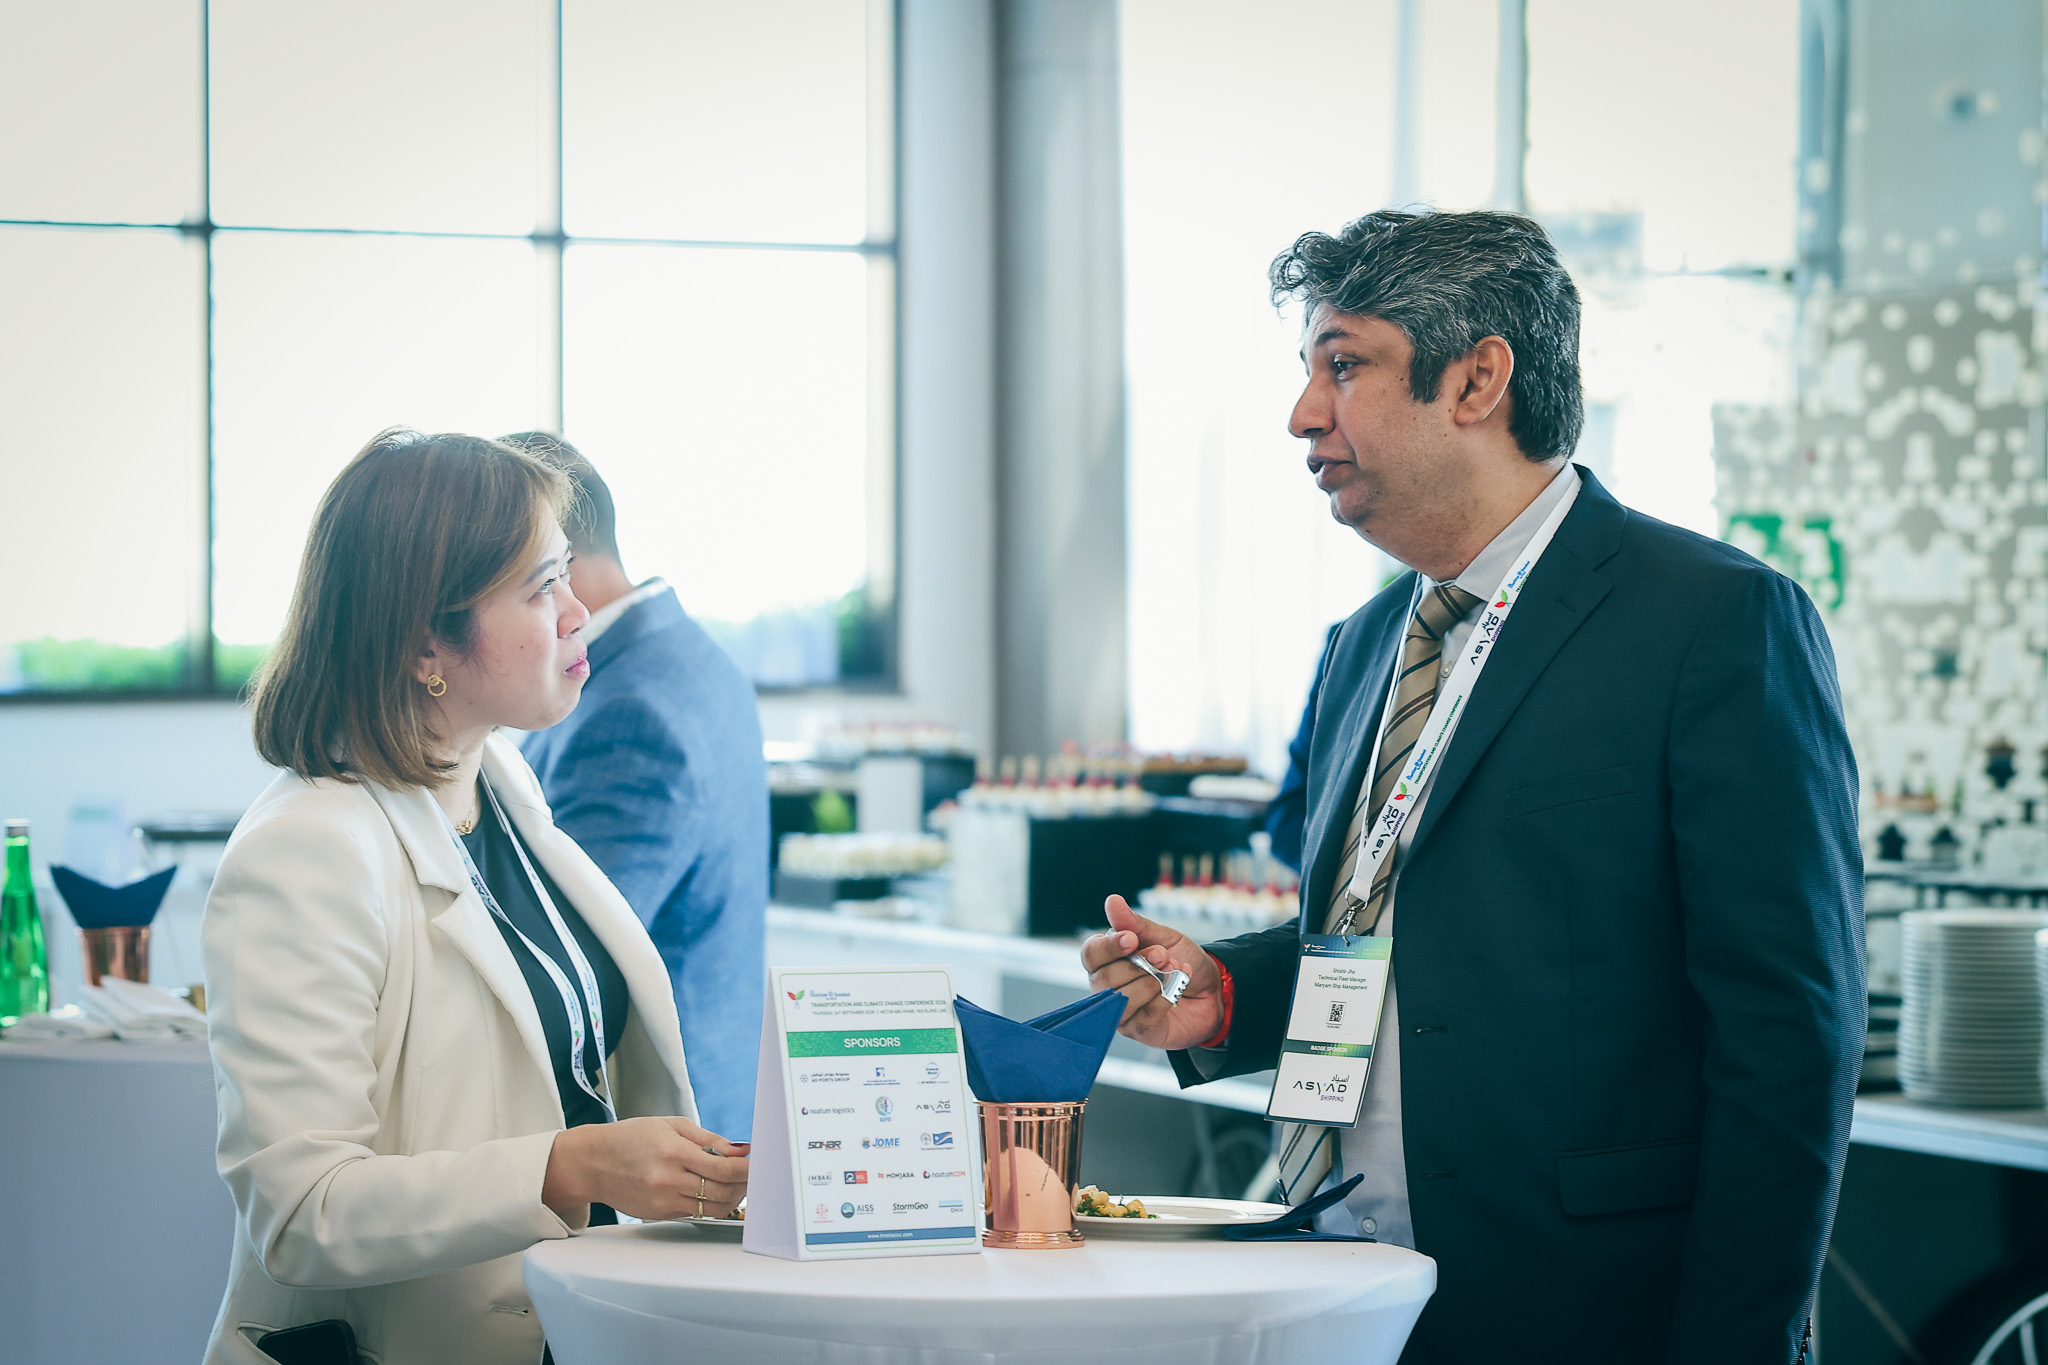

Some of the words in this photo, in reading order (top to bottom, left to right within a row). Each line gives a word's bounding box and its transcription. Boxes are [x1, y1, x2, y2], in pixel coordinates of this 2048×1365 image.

[1471, 615, 1499, 666] ASYAD
[1391, 811, 1406, 836] SHIPPING
[1371, 808, 1399, 860] ASYAD
[843, 1036, 901, 1048] SPONSORS
[1293, 1080, 1347, 1095] ASYAD
[1320, 1094, 1345, 1102] SHIPPING
[832, 1107, 855, 1115] logistics
[916, 1103, 951, 1111] ASYAD
[872, 1137, 900, 1147] JOME
[856, 1204, 875, 1213] AISS
[892, 1201, 929, 1211] StormGeo
